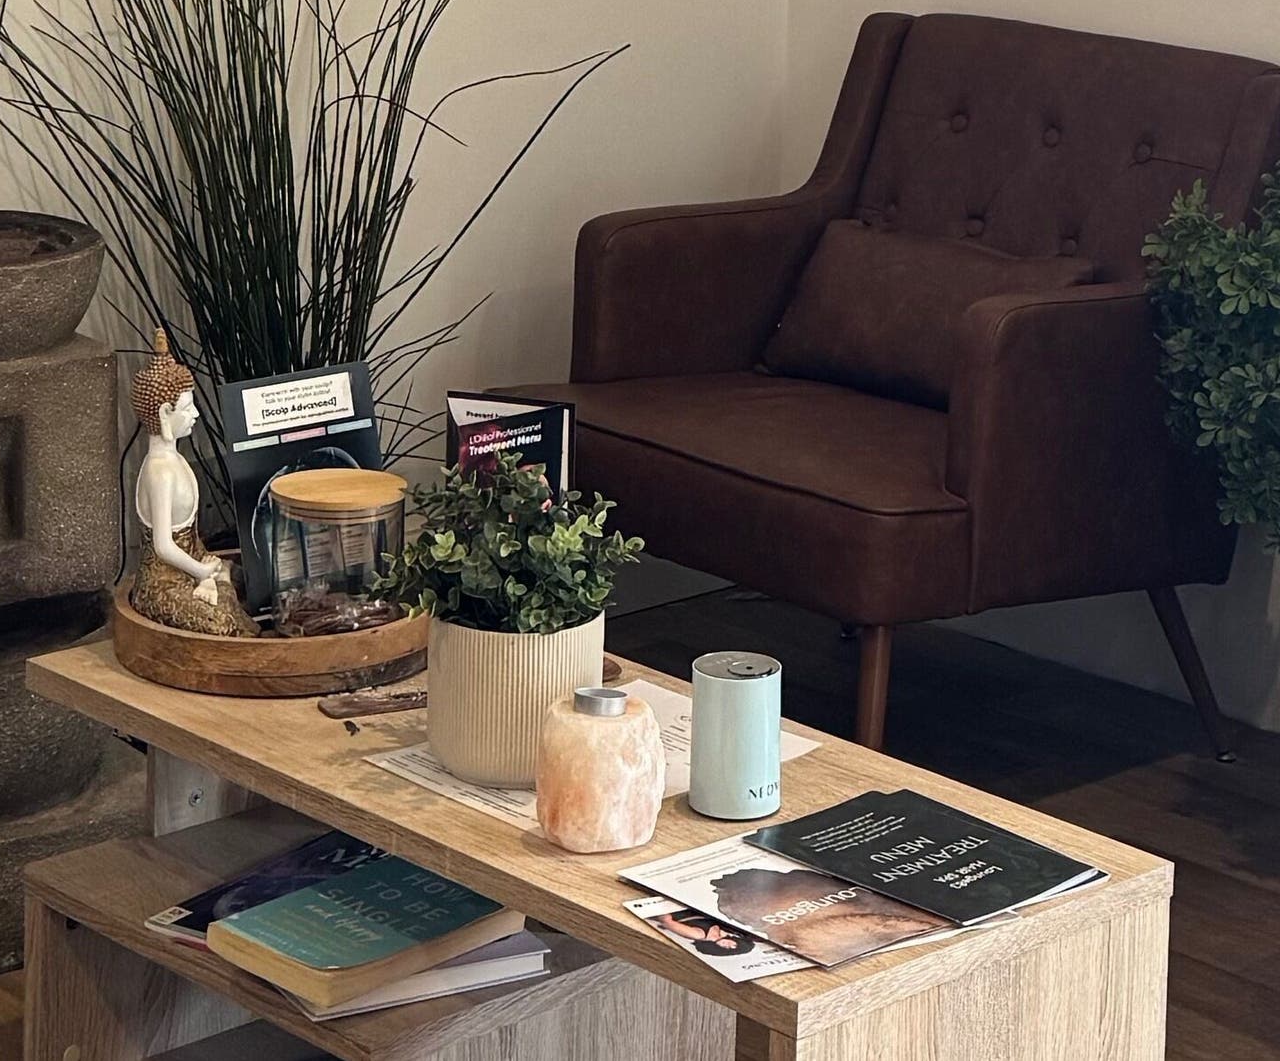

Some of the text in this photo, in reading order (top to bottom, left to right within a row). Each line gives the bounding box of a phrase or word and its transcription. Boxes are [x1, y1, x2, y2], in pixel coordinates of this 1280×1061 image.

[468, 433, 542, 456] Treatment Menu
[869, 835, 935, 864] MENU
[871, 835, 989, 883] TREATMENT
[367, 881, 450, 921] TO BE
[402, 872, 474, 903] HOW
[318, 888, 427, 939] SINGLE
